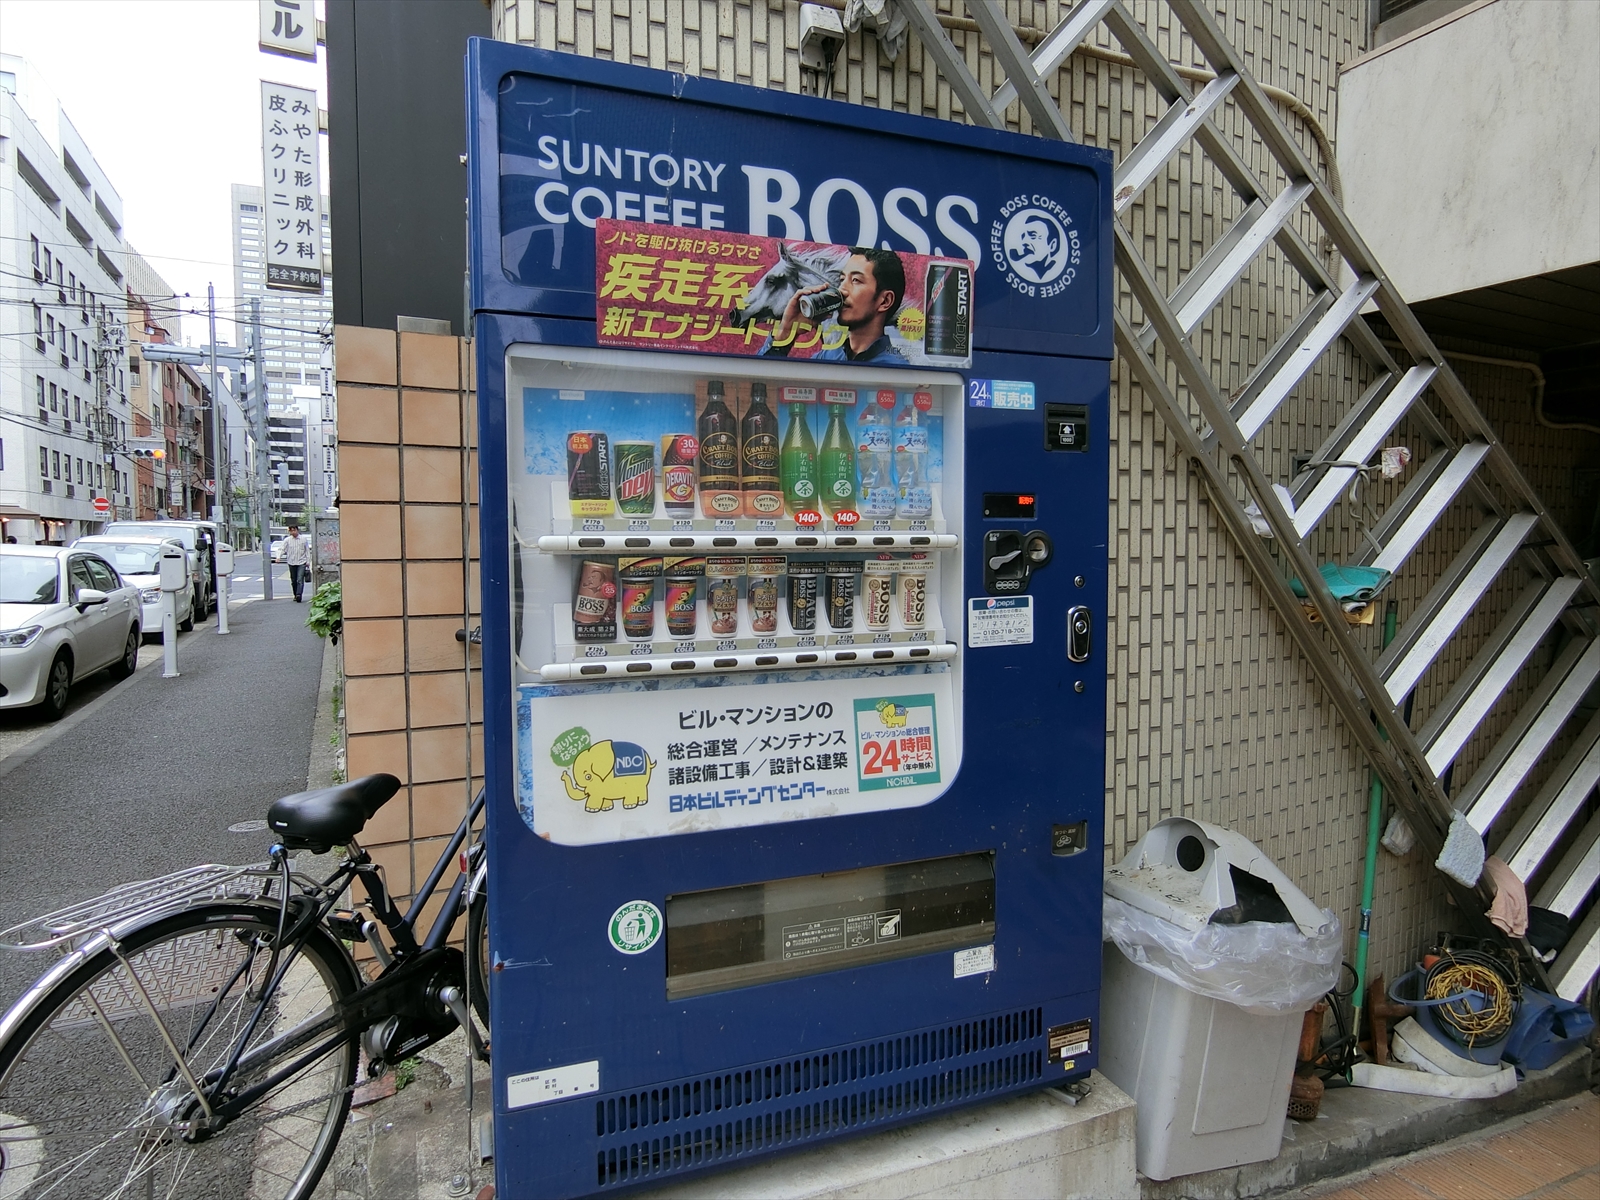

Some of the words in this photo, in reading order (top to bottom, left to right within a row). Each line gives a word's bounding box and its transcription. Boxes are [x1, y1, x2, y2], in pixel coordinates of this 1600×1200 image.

[268, 94, 291, 255] 皮ふクリニック
[537, 134, 727, 193] SUNTORY
[291, 99, 316, 260] みやた形成外科
[534, 181, 725, 231] COFFEE
[740, 164, 982, 272] BOSS
[999, 194, 1029, 218] BOSS
[1032, 194, 1073, 227] COFFEE
[604, 230, 762, 260] ノドを駆け抜けるウマさ
[990, 220, 1008, 272] COFFEE
[1068, 229, 1081, 265] BOSS
[268, 267, 320, 285] 完全予約制
[599, 253, 767, 310] 疾走系
[1005, 272, 1036, 298] BOSS
[1040, 267, 1076, 298] COFFEE
[902, 317, 924, 325] グレープ
[952, 270, 968, 350] KICKSTART
[601, 305, 850, 350] 新エナジードリンク
[970, 380, 992, 400] 24h
[994, 391, 1033, 408] 販売中
[702, 444, 726, 454] CRAFT
[746, 446, 768, 455] CRAFT
[598, 438, 609, 496] KICKSTART
[800, 452, 808, 478] 伊右衛門
[838, 452, 846, 478] 伊右衛門
[676, 484, 688, 496] C
[797, 482, 812, 496] 茶
[835, 482, 850, 496] 茶
[798, 513, 818, 522] 140円
[837, 512, 857, 522] 140円
[579, 600, 604, 612] BOSS
[630, 604, 650, 612] BOSS
[806, 579, 816, 628] BLACK
[844, 578, 854, 627] BLACK
[879, 579, 890, 624] BOSS
[916, 578, 926, 622] BOSS
[996, 599, 1015, 607] pepsi
[678, 702, 834, 730] ビル・マンションの
[551, 732, 579, 755] 頼りに
[861, 726, 930, 740] ビル・マンションの総合管理
[560, 734, 590, 761] なるゾウ
[862, 740, 901, 775] 24
[900, 736, 932, 753] 時間
[901, 752, 933, 763] サービス
[616, 756, 643, 769] NBC
[668, 752, 848, 786] 諸設備工事／設計&建築
[669, 782, 826, 813] 日本ビルディングセンター
[826, 787, 850, 796] 株式会社
[616, 904, 656, 922] のんだあとは
[618, 936, 653, 950] リサイクル
[512, 1075, 539, 1084] ここの住所は
